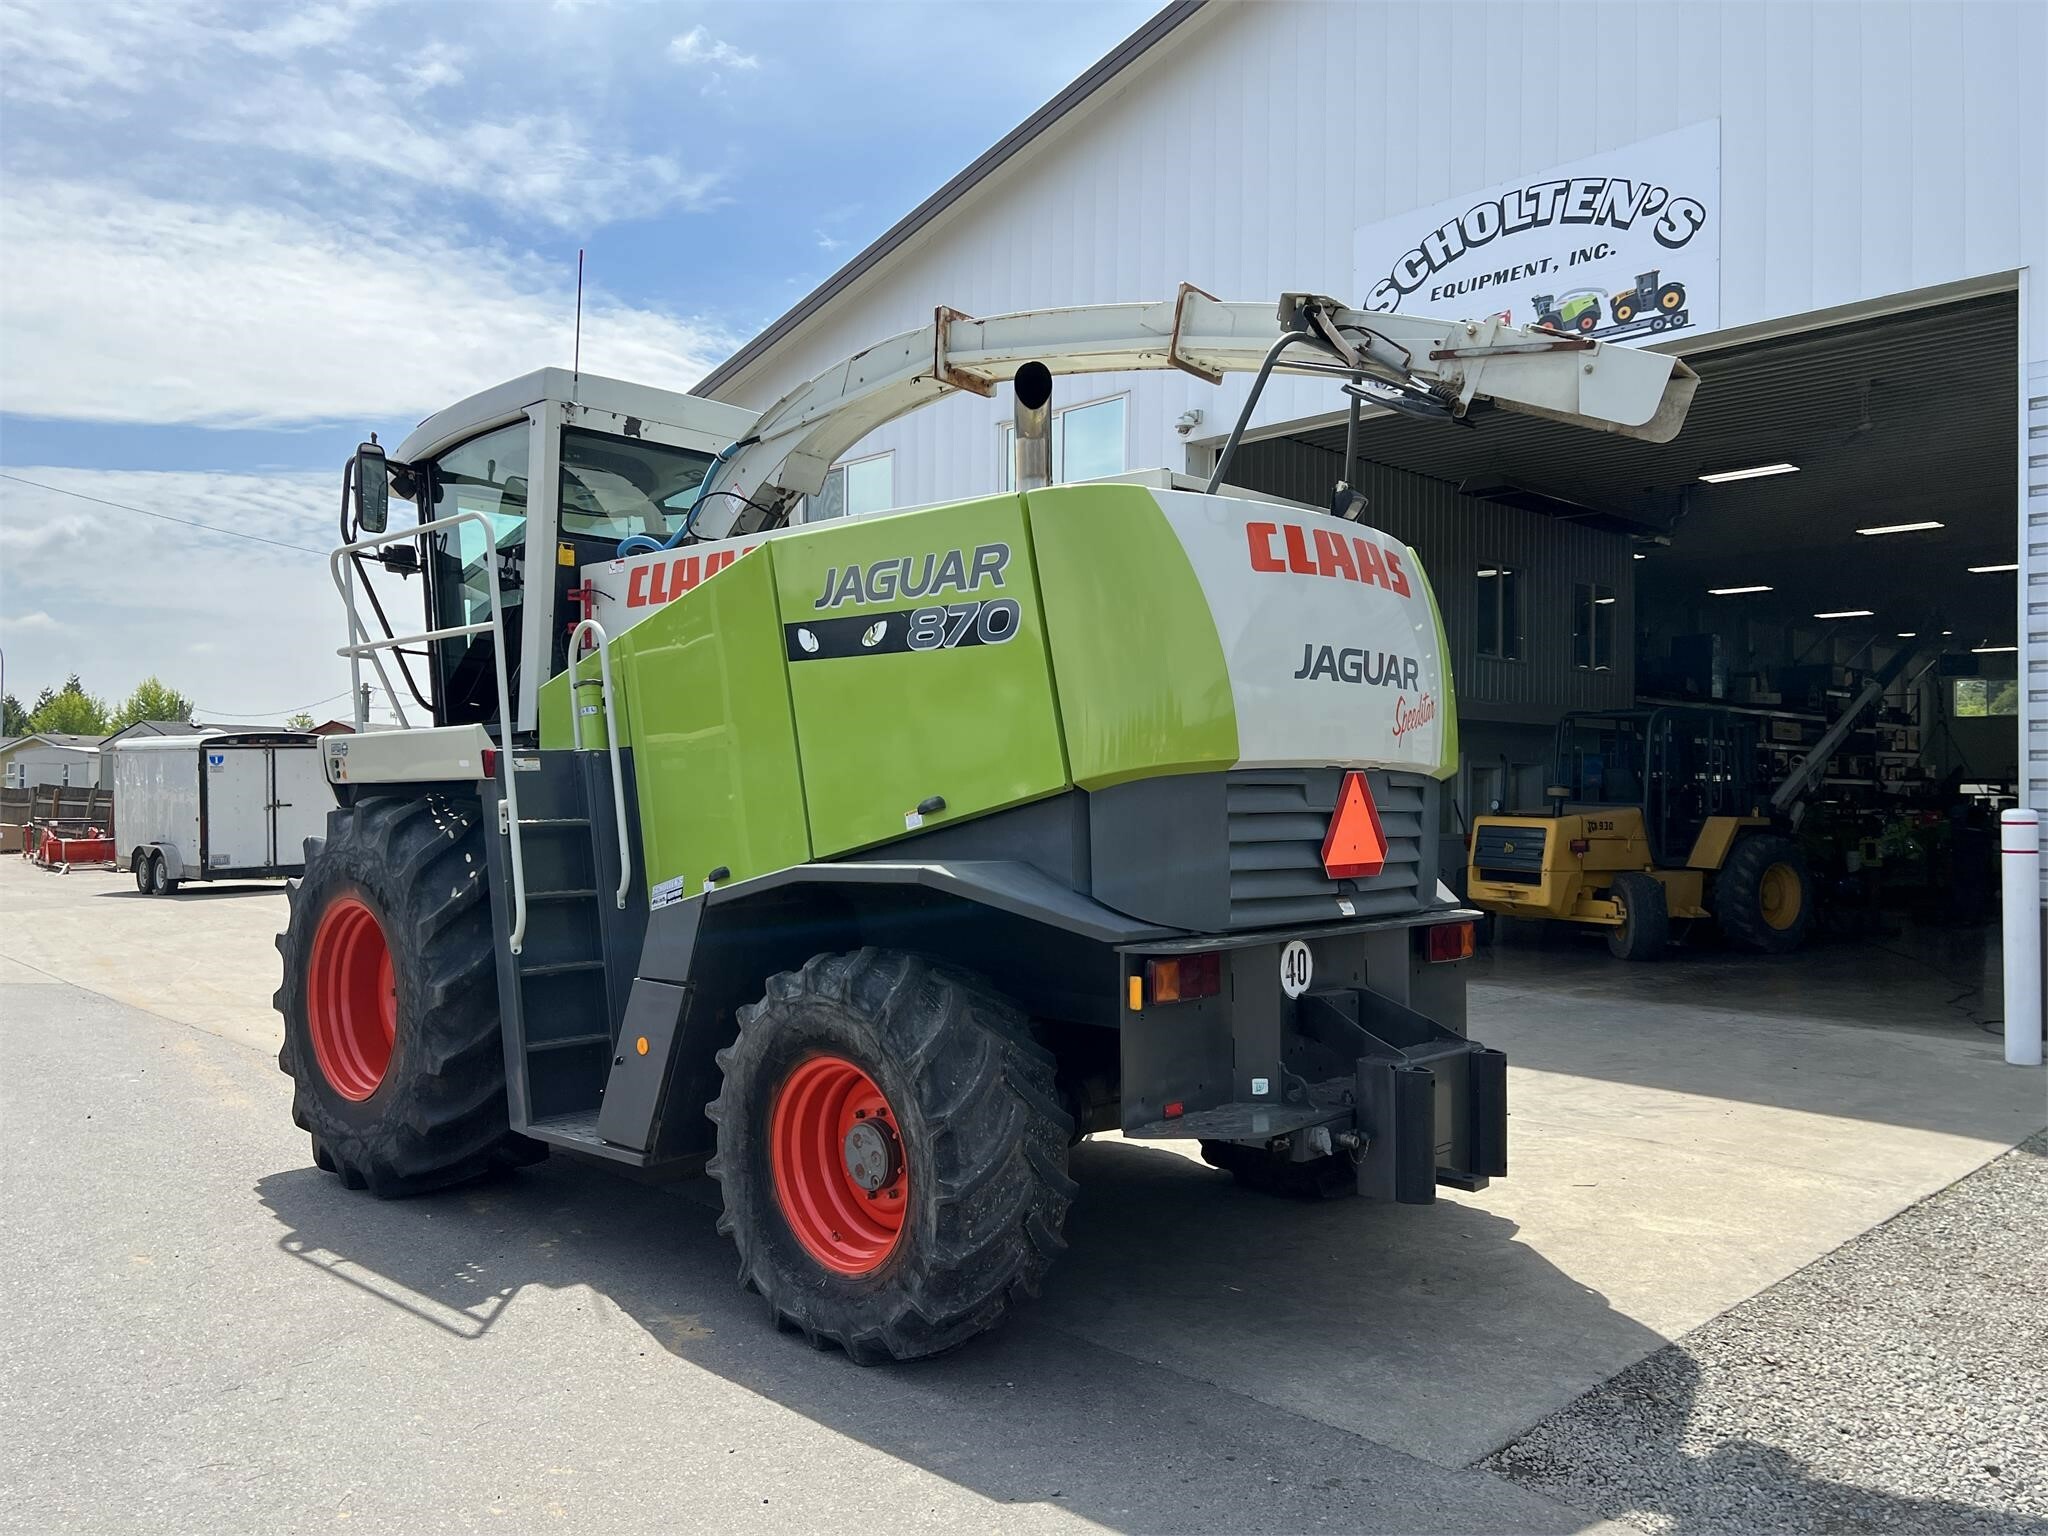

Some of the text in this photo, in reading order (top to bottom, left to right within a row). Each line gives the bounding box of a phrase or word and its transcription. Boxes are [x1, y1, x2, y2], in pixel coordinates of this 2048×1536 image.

[1363, 177, 1706, 314] SCHOLTEN'S
[1430, 242, 1617, 301] EQUIPMENT, INC.
[813, 541, 1012, 610] JAGUAR
[1246, 522, 1411, 599] CLAAS
[906, 598, 1022, 651] 870
[1294, 643, 1419, 692] JAGUAR
[1285, 948, 1307, 987] 40
